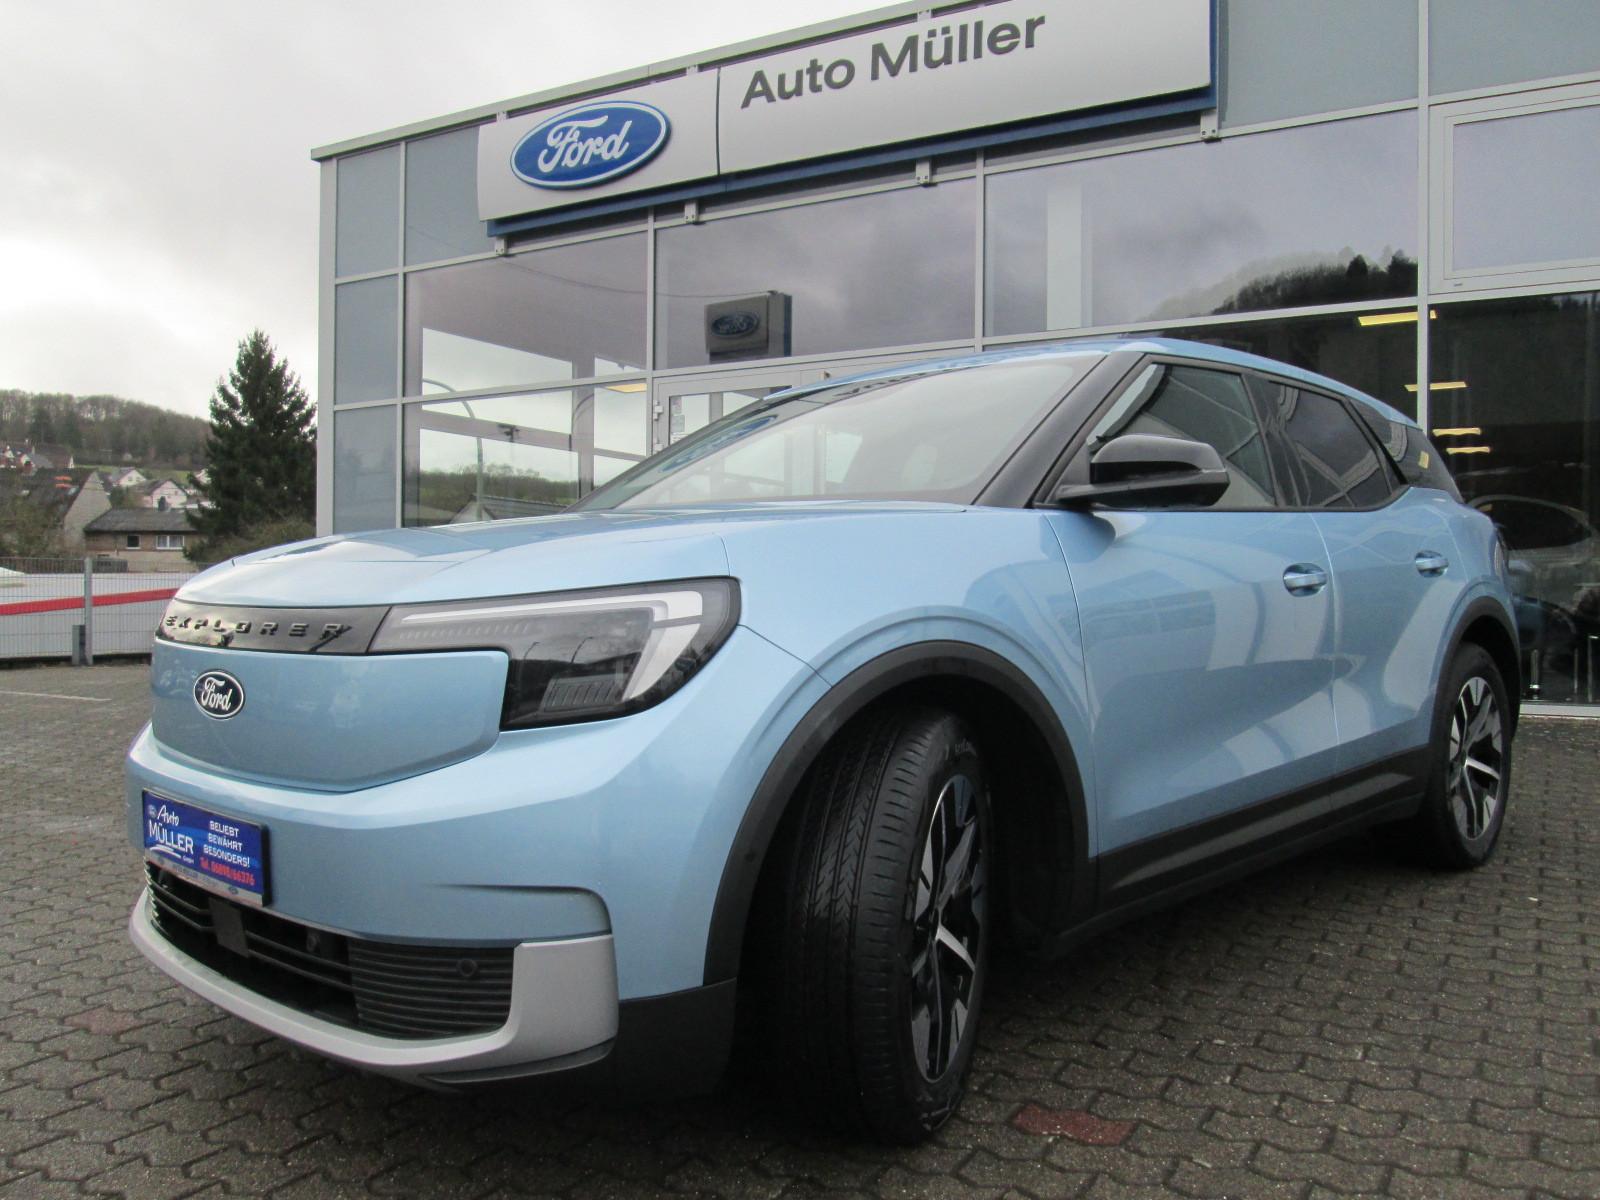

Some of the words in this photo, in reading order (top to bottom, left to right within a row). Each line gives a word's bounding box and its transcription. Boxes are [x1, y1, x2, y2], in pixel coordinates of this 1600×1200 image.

[740, 58, 856, 109] Auto
[870, 15, 1046, 81] Müller
[537, 115, 633, 173] Ford
[166, 616, 349, 639] EXPLORER
[201, 676, 232, 711] Ford
[157, 804, 180, 826] Auto
[149, 819, 194, 855] MÜLLER
[209, 820, 240, 838] BELIEBT
[207, 832, 243, 852] BEWÄHRT
[203, 843, 251, 868] BESONDERS!
